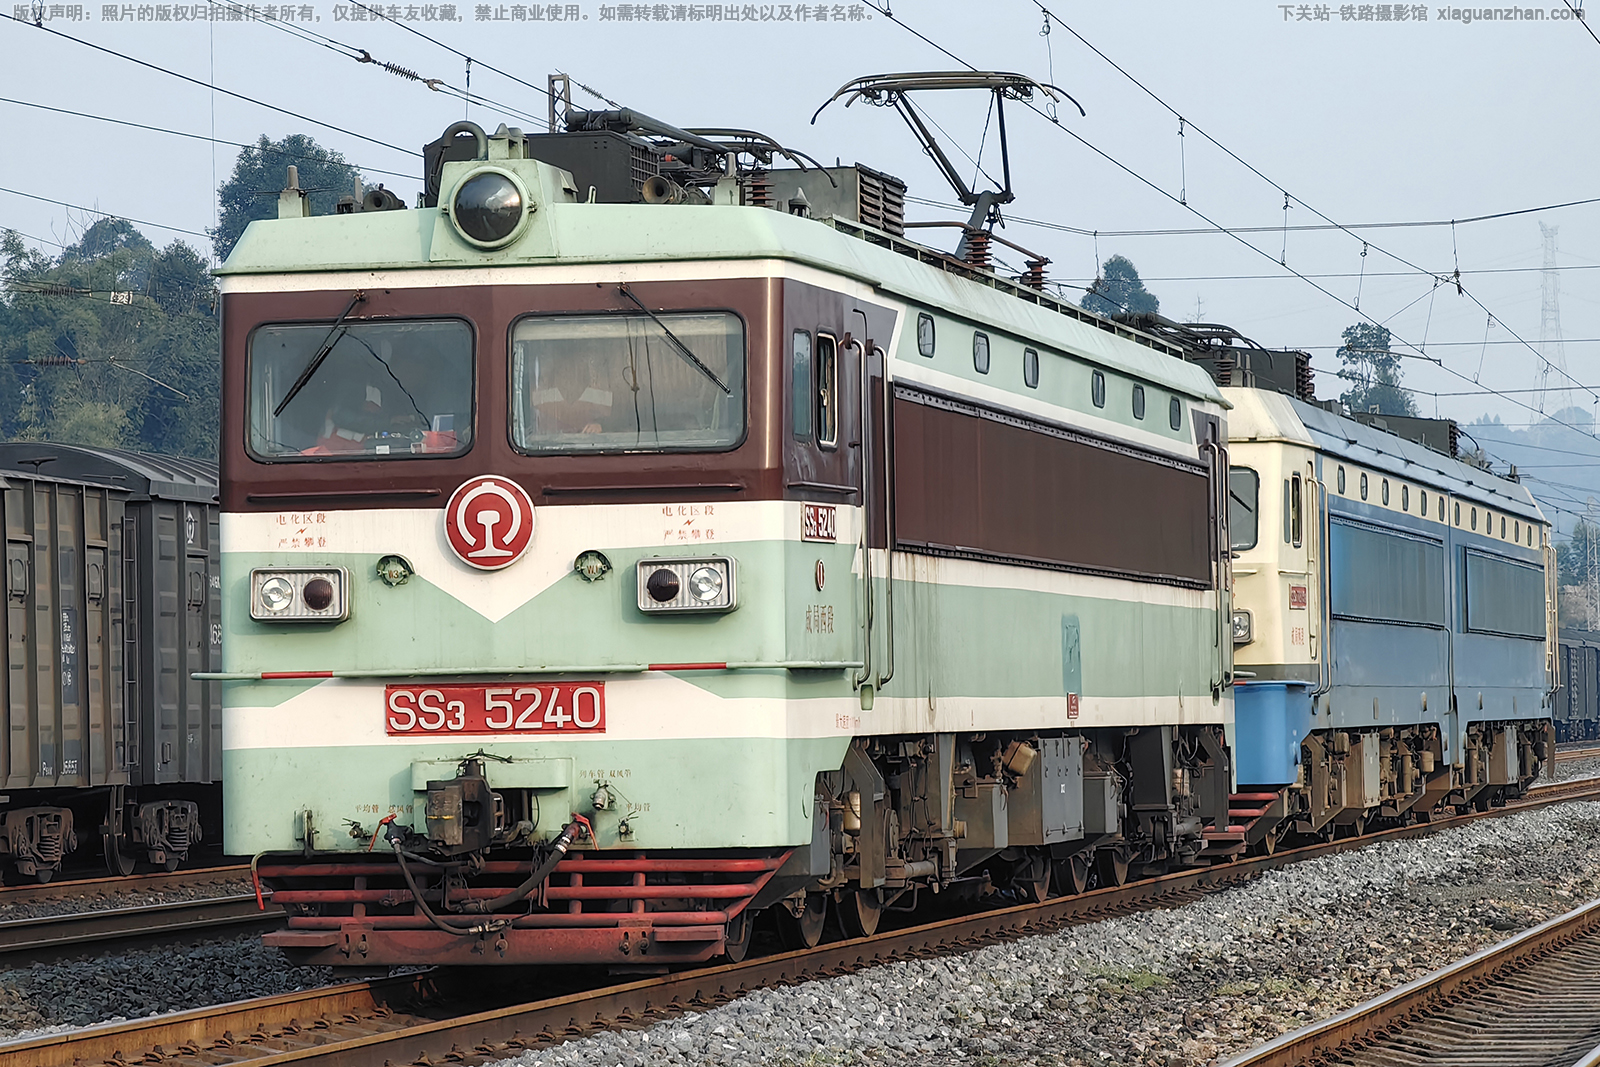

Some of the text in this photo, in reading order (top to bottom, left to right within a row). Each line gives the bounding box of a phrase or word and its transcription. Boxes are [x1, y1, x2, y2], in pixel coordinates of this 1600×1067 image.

[663, 505, 714, 517] 电化区段
[276, 513, 326, 525] 电化区段
[818, 507, 837, 539] 5240
[664, 529, 715, 541] 严禁攀登
[278, 537, 326, 548] 严禁攀登
[389, 687, 601, 731] SS3 5240
